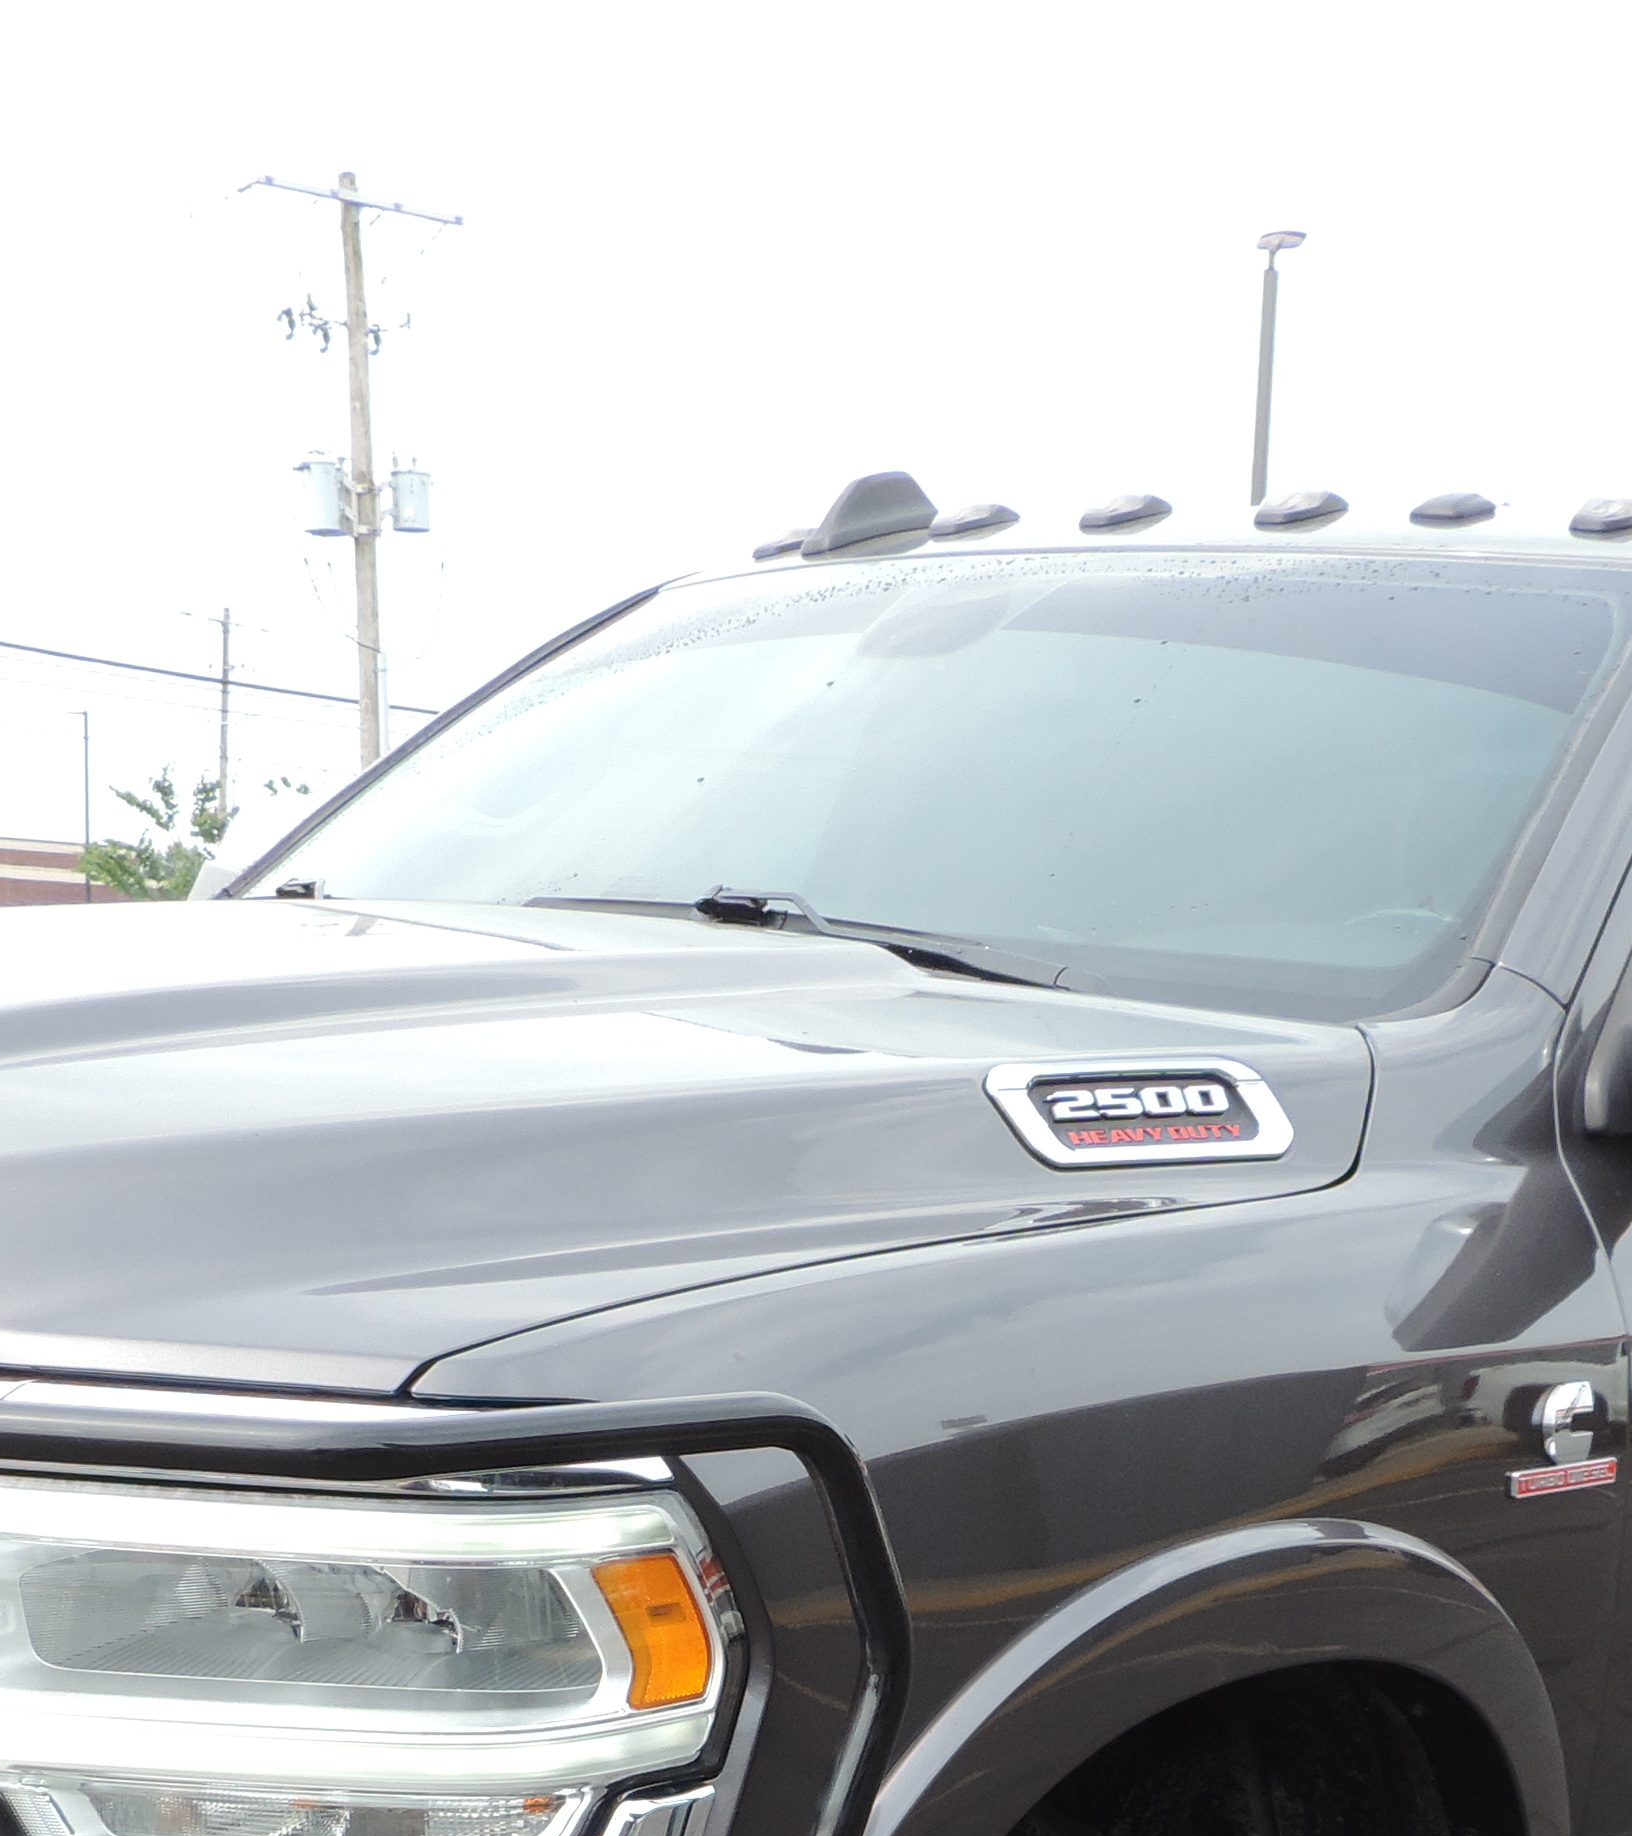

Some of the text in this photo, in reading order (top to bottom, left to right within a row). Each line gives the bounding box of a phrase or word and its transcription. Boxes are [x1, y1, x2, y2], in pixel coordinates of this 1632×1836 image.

[1044, 1084, 1230, 1122] 2500
[1068, 1124, 1241, 1146] HEAVY DUTY
